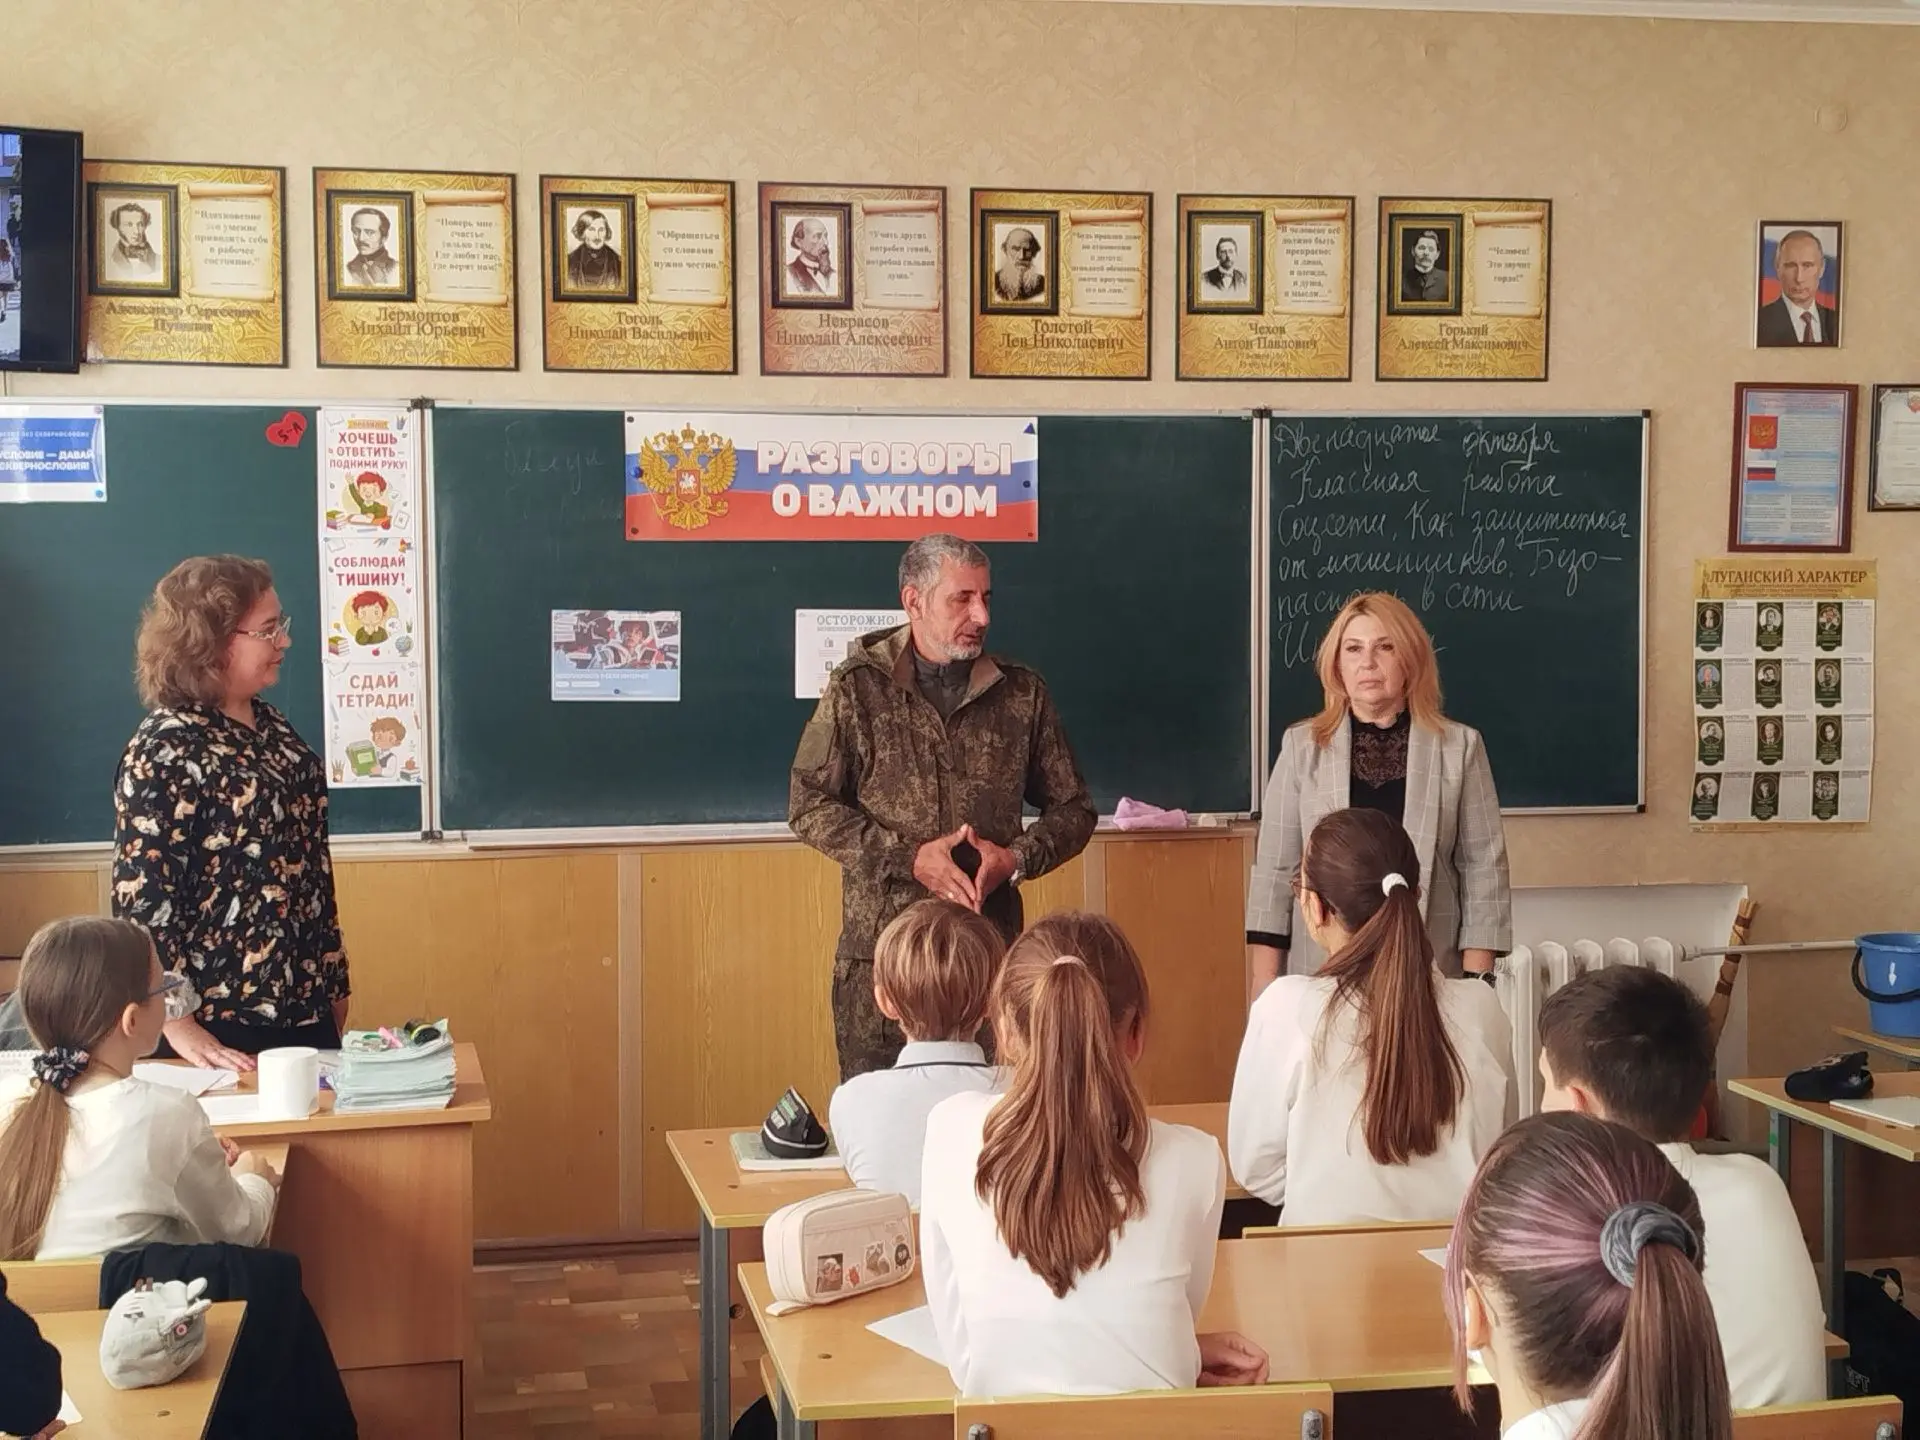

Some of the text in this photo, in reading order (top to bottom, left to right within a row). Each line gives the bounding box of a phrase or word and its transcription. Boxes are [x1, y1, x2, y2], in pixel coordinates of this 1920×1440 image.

[870, 244, 904, 254] потребен
[654, 261, 683, 270] нужно
[1487, 260, 1531, 270] Это звучит
[376, 308, 461, 326] Лермонтов
[615, 312, 664, 327] Гоголь
[818, 313, 890, 331] Некрасов
[154, 319, 214, 334] Пушкин
[349, 320, 486, 340] Михаил Юрьевич
[567, 325, 713, 342] Николай Васильевич
[1031, 318, 1094, 335] Толстой
[1249, 323, 1287, 336] Чехов
[1439, 323, 1489, 340] Горький
[776, 328, 933, 347] Николай Алексеевич
[999, 334, 1124, 351] Лев Николаевич
[1213, 337, 1318, 351] Антон Павлович
[1396, 337, 1529, 352] Алексей Максимович
[338, 432, 398, 445] ХОЧЕШЬ
[1462, 423, 1561, 471] октября
[336, 446, 396, 458] ОТВЕТИТЬ
[757, 440, 1013, 477] РАЗГОВОРЫ
[329, 459, 408, 471] ПОДНИМИ РУКУ!
[1290, 455, 1563, 518] Классная работа
[772, 483, 999, 518] О ВАЖНОМ
[333, 554, 406, 568] СОБЛЮДАЙ
[1278, 556, 1309, 581] от
[336, 572, 406, 587] ТИШИНУ!
[1708, 568, 1868, 584] ЛУГАНСКИЙ ХАРАКТЕР
[1421, 570, 1435, 612] в
[1445, 582, 1525, 612] сети
[816, 615, 899, 627] ОСТОРОЖНО!
[349, 671, 399, 690] СДАЙ
[336, 692, 415, 709] ТЕТРАДИ!
